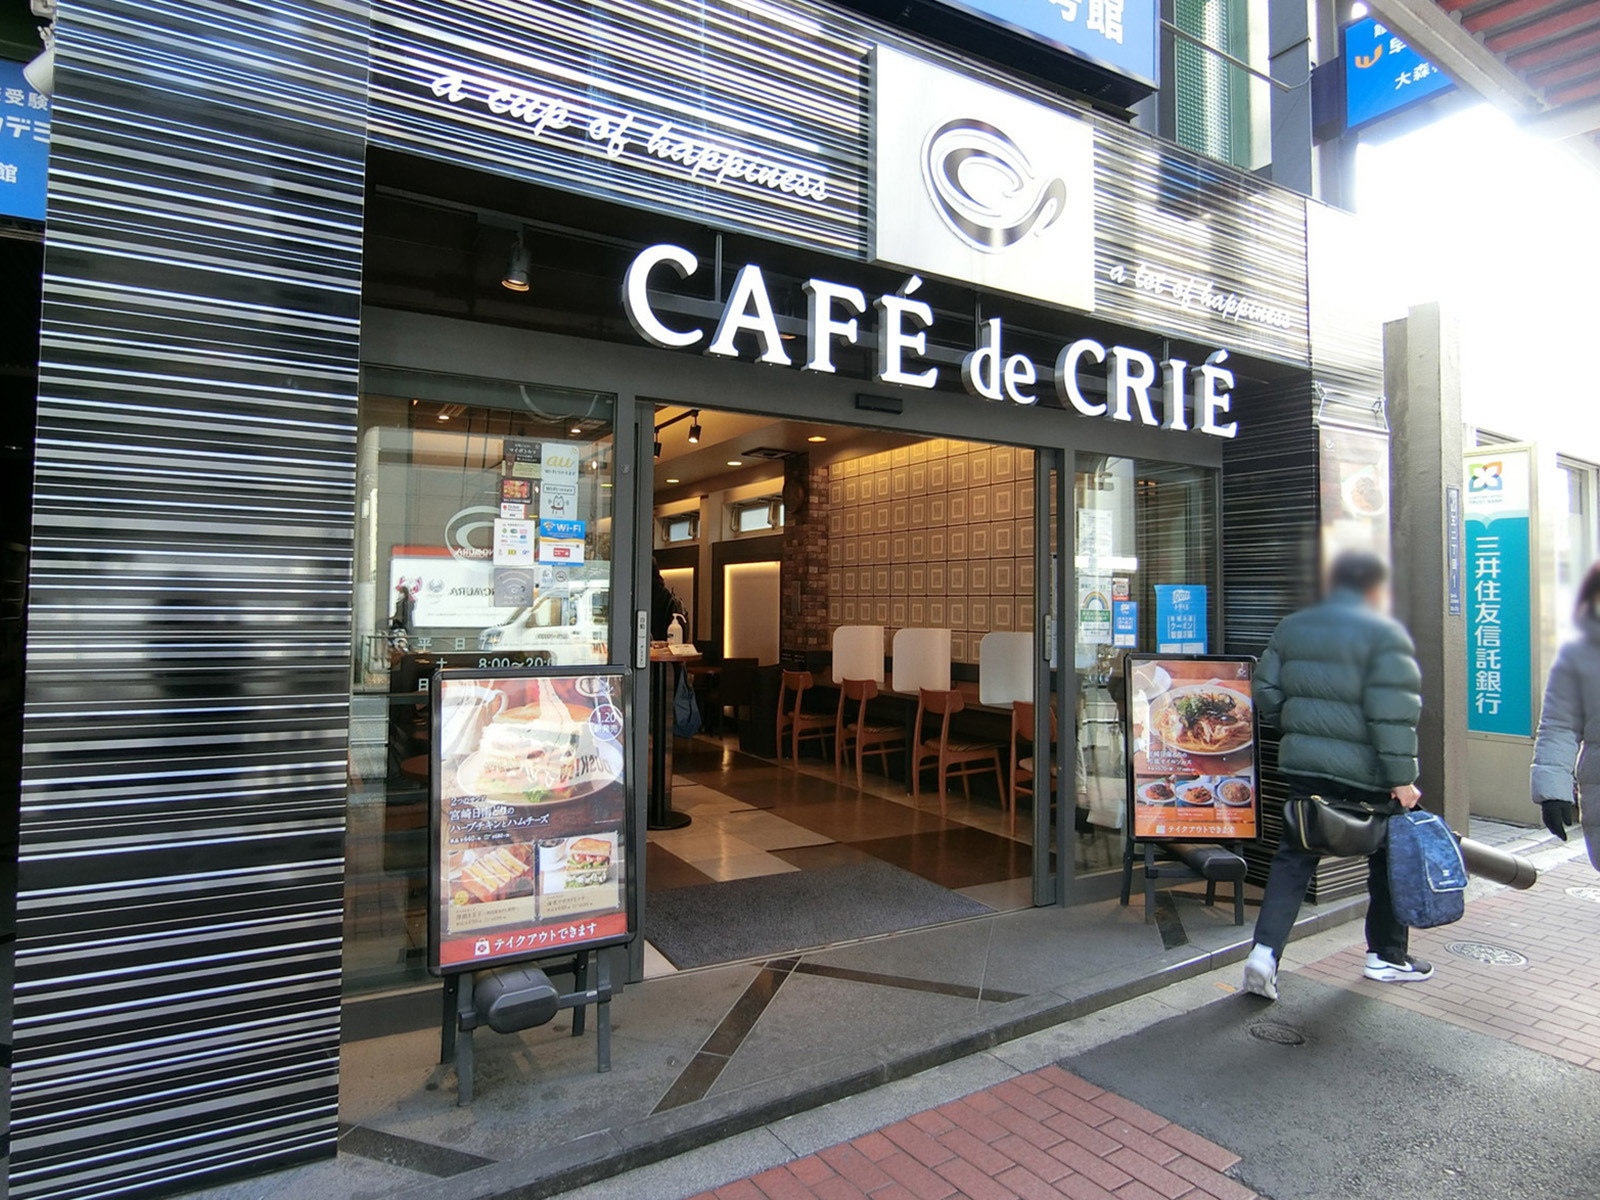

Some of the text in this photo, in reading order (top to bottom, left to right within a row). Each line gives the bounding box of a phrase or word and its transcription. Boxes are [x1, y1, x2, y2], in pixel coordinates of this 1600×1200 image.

[1394, 61, 1438, 90] 大森
[0, 87, 49, 111] 受験
[0, 115, 50, 144] デミ
[431, 70, 829, 200] a cup of happiness
[1109, 262, 1291, 329] a lot of happiness
[624, 243, 1238, 439] CAFÉ de CRIÉ
[556, 522, 582, 533] Wi-Fi
[1474, 536, 1502, 716] 三井住友信託銀行
[494, 922, 598, 951] テイクアウトできます
